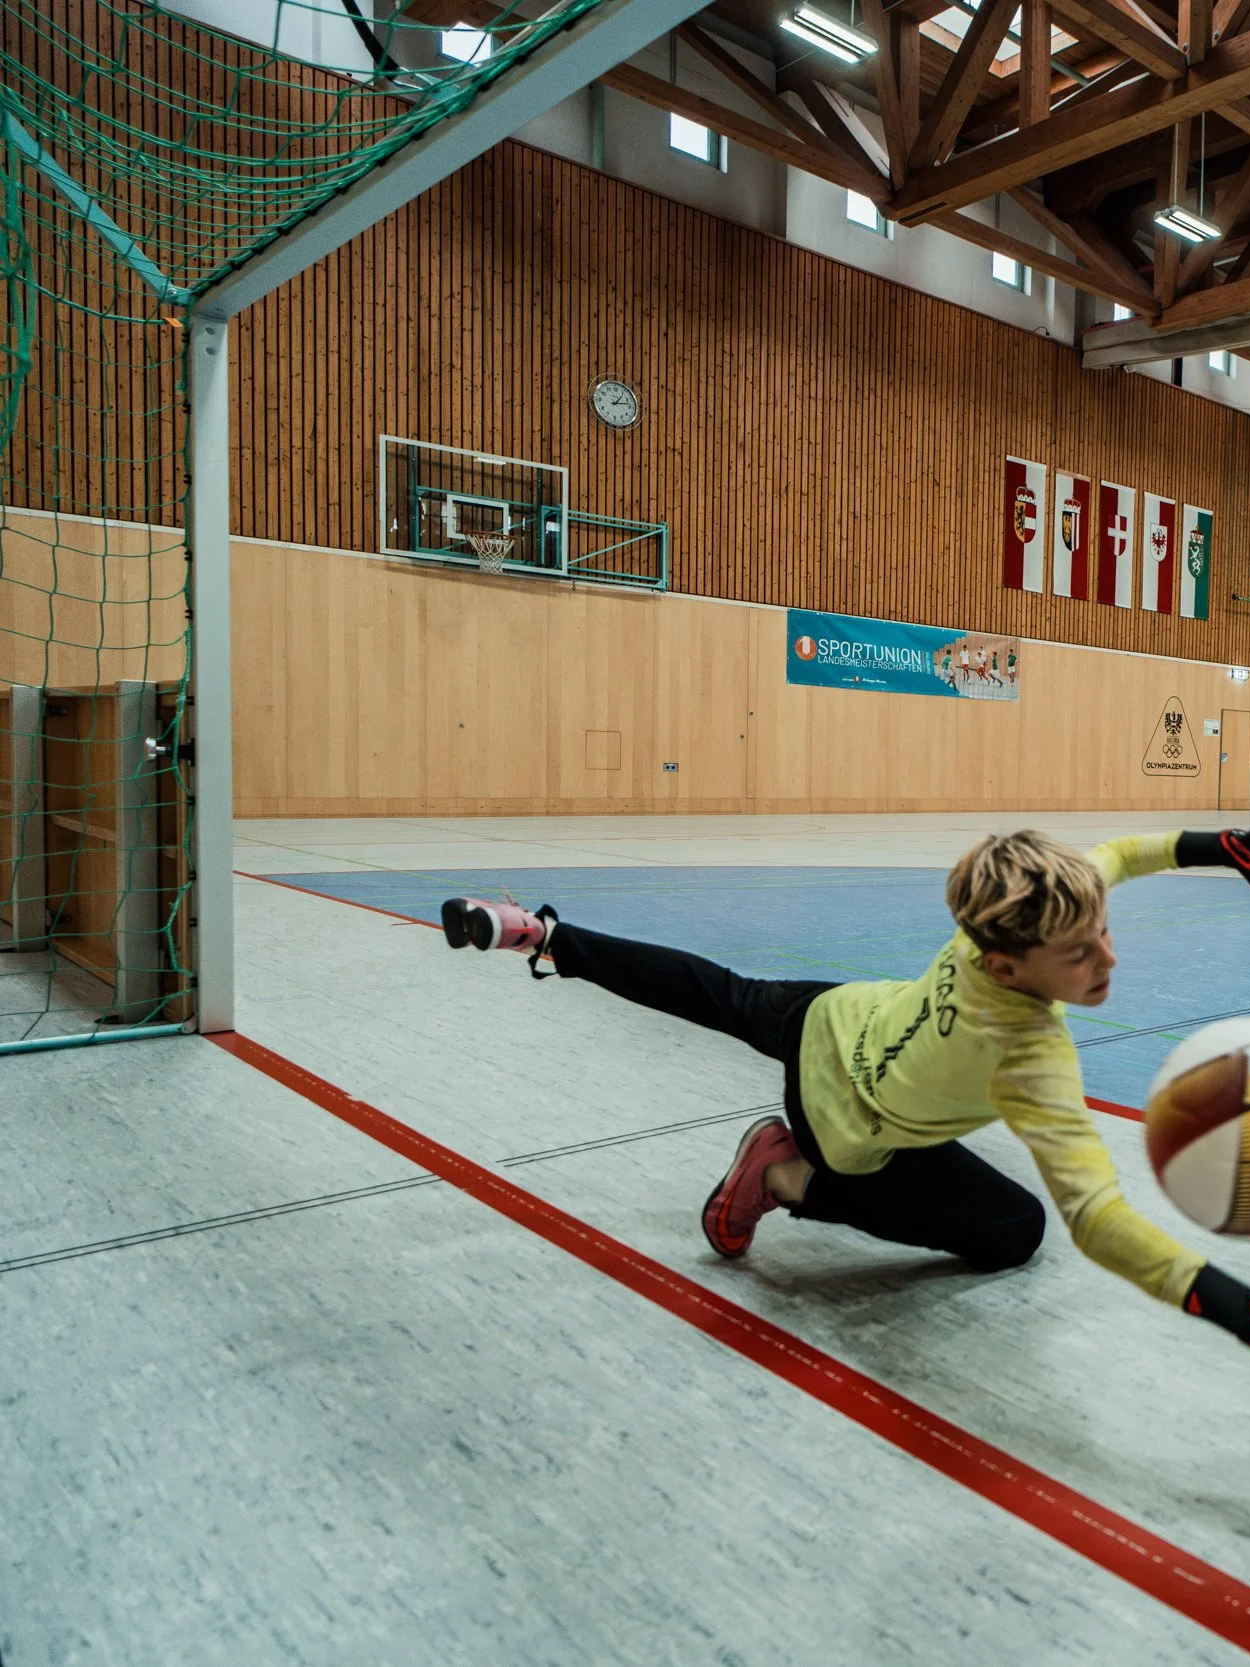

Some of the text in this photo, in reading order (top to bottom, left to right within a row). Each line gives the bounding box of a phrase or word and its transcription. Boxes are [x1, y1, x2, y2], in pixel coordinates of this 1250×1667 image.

[818, 638, 921, 665] SPORTUNION
[817, 655, 922, 673] LANDESMEISTERSCHAFTEN
[1146, 761, 1197, 771] OLYMPIAZENTRUM
